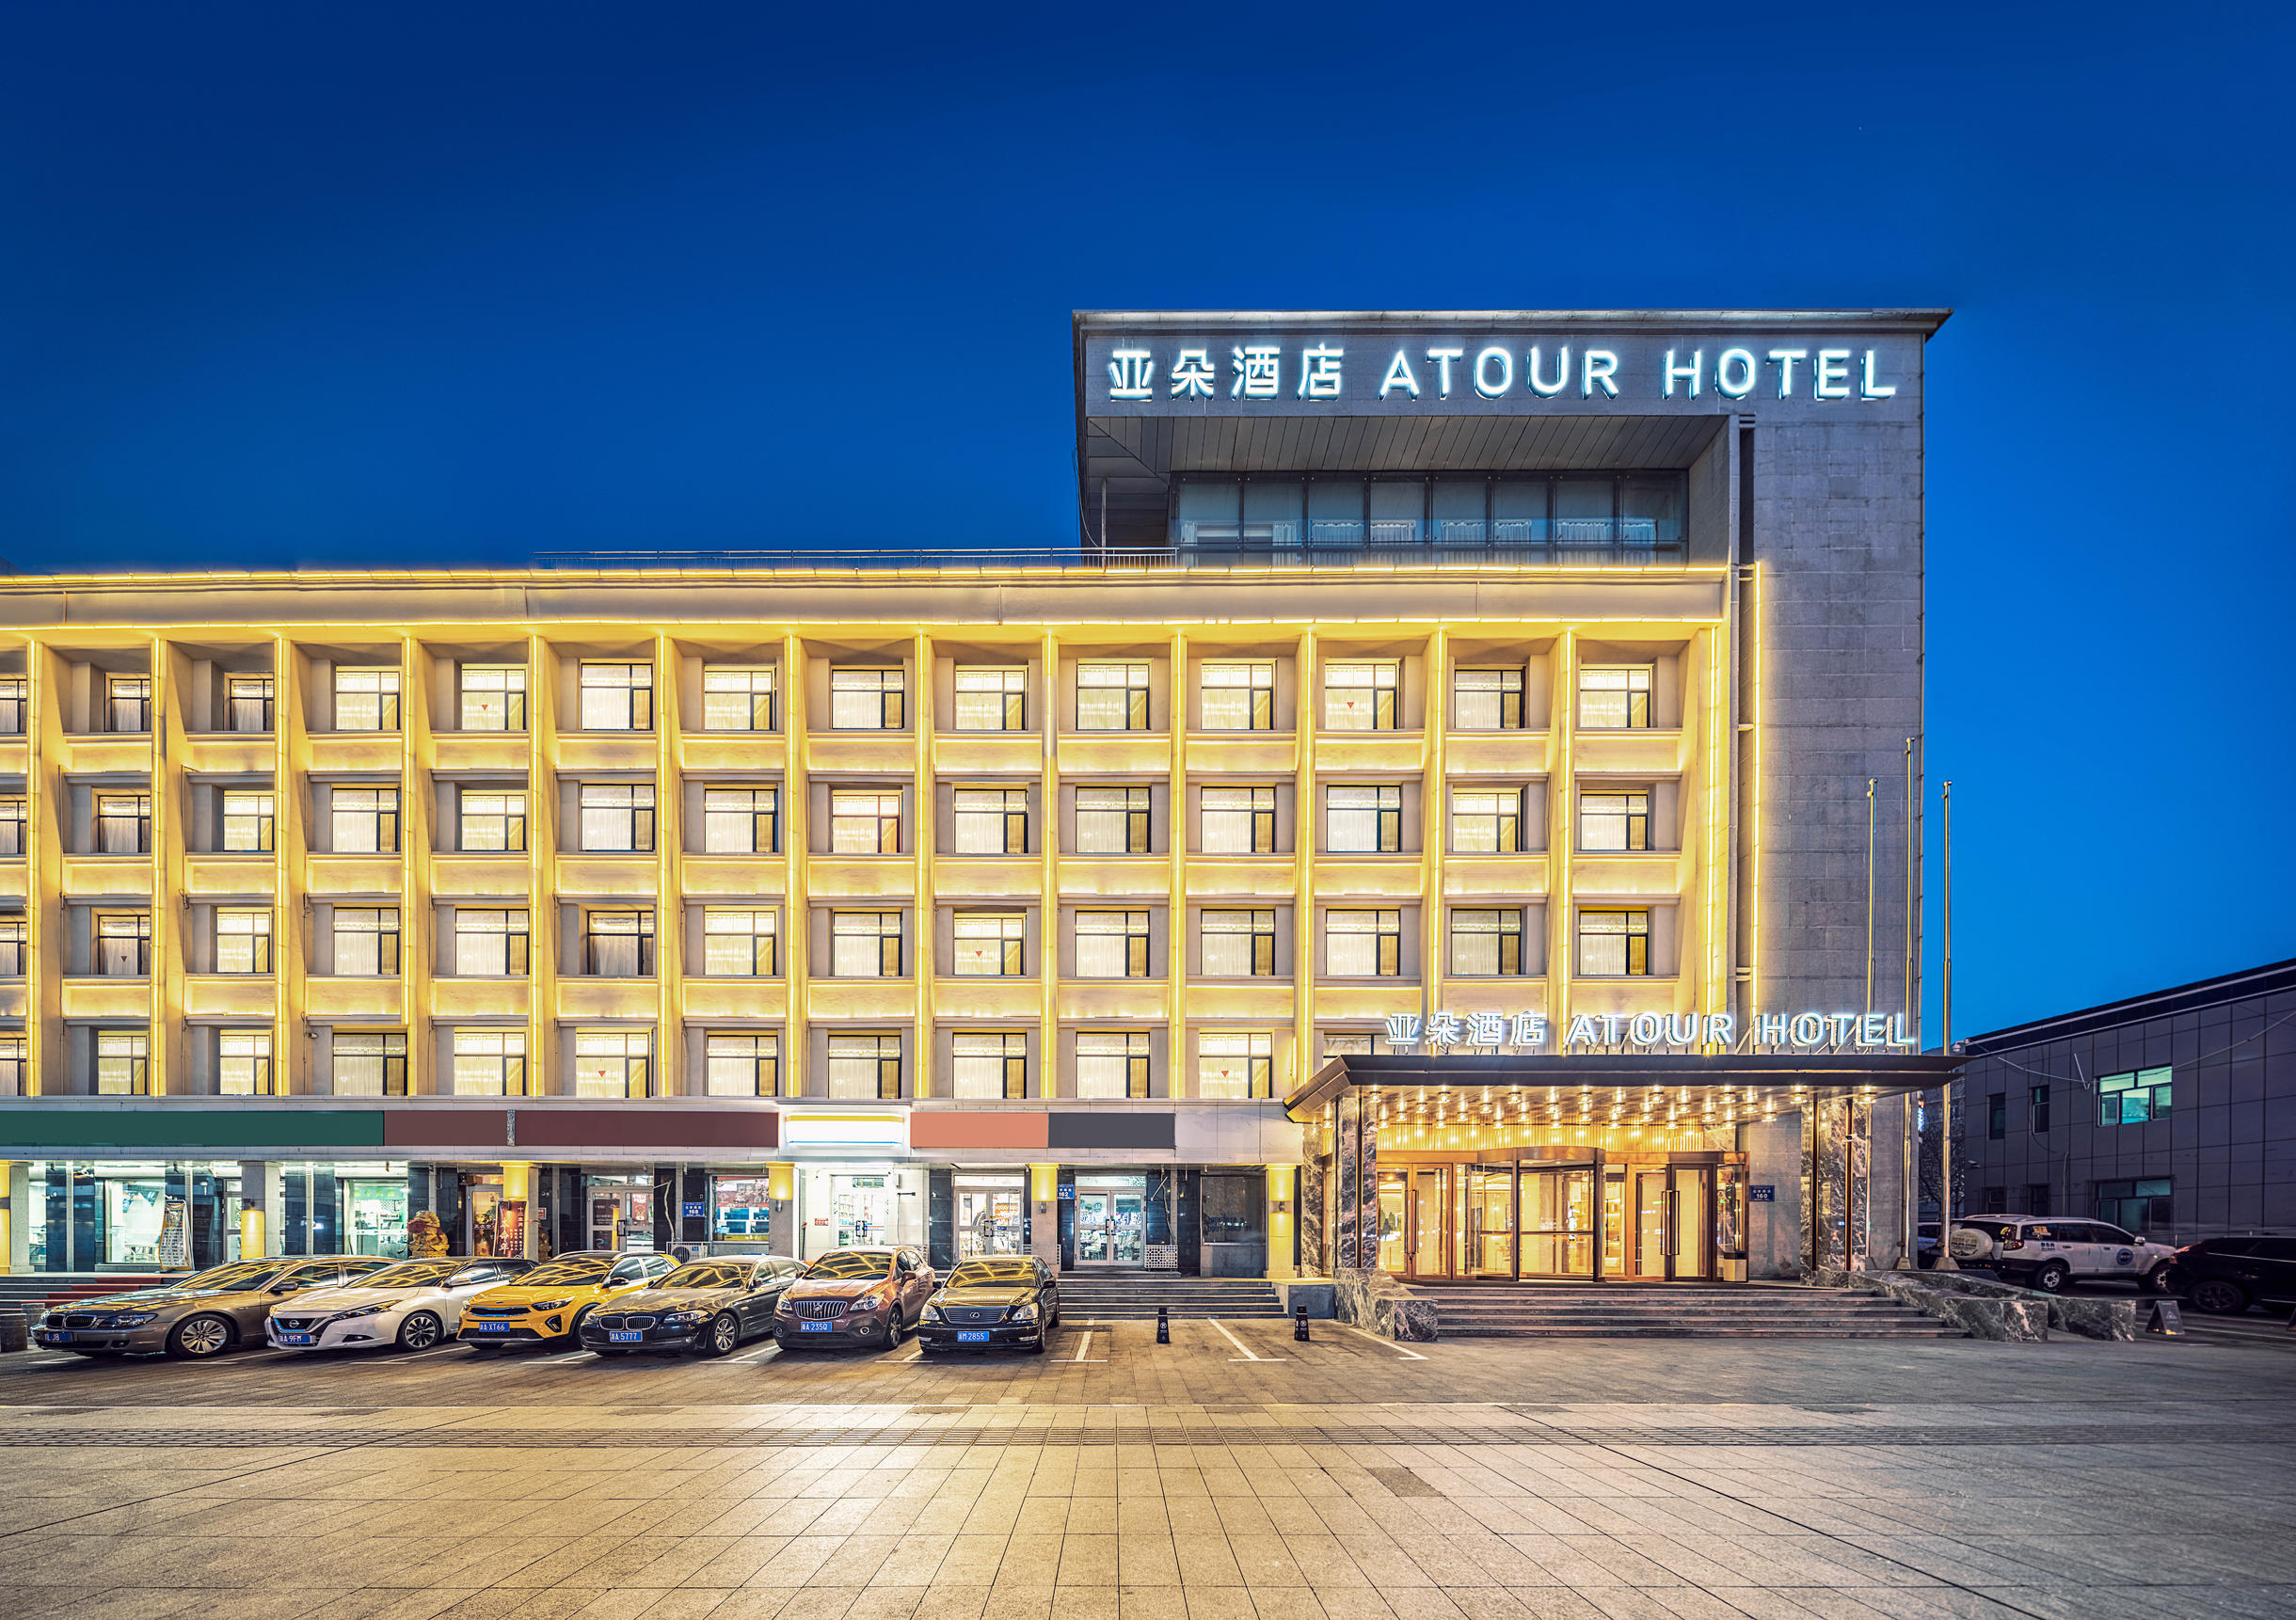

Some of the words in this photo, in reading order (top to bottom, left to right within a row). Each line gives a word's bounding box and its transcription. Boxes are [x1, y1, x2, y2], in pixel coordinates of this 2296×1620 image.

[1108, 342, 1346, 402] 亚朵酒店
[1379, 346, 1622, 402] ATOUR
[1663, 346, 1899, 402] HOTEL
[1384, 1011, 1547, 1047] 亚朵酒店
[1565, 1011, 1734, 1046] ATOUR
[1752, 1011, 1917, 1049] HOTEL
